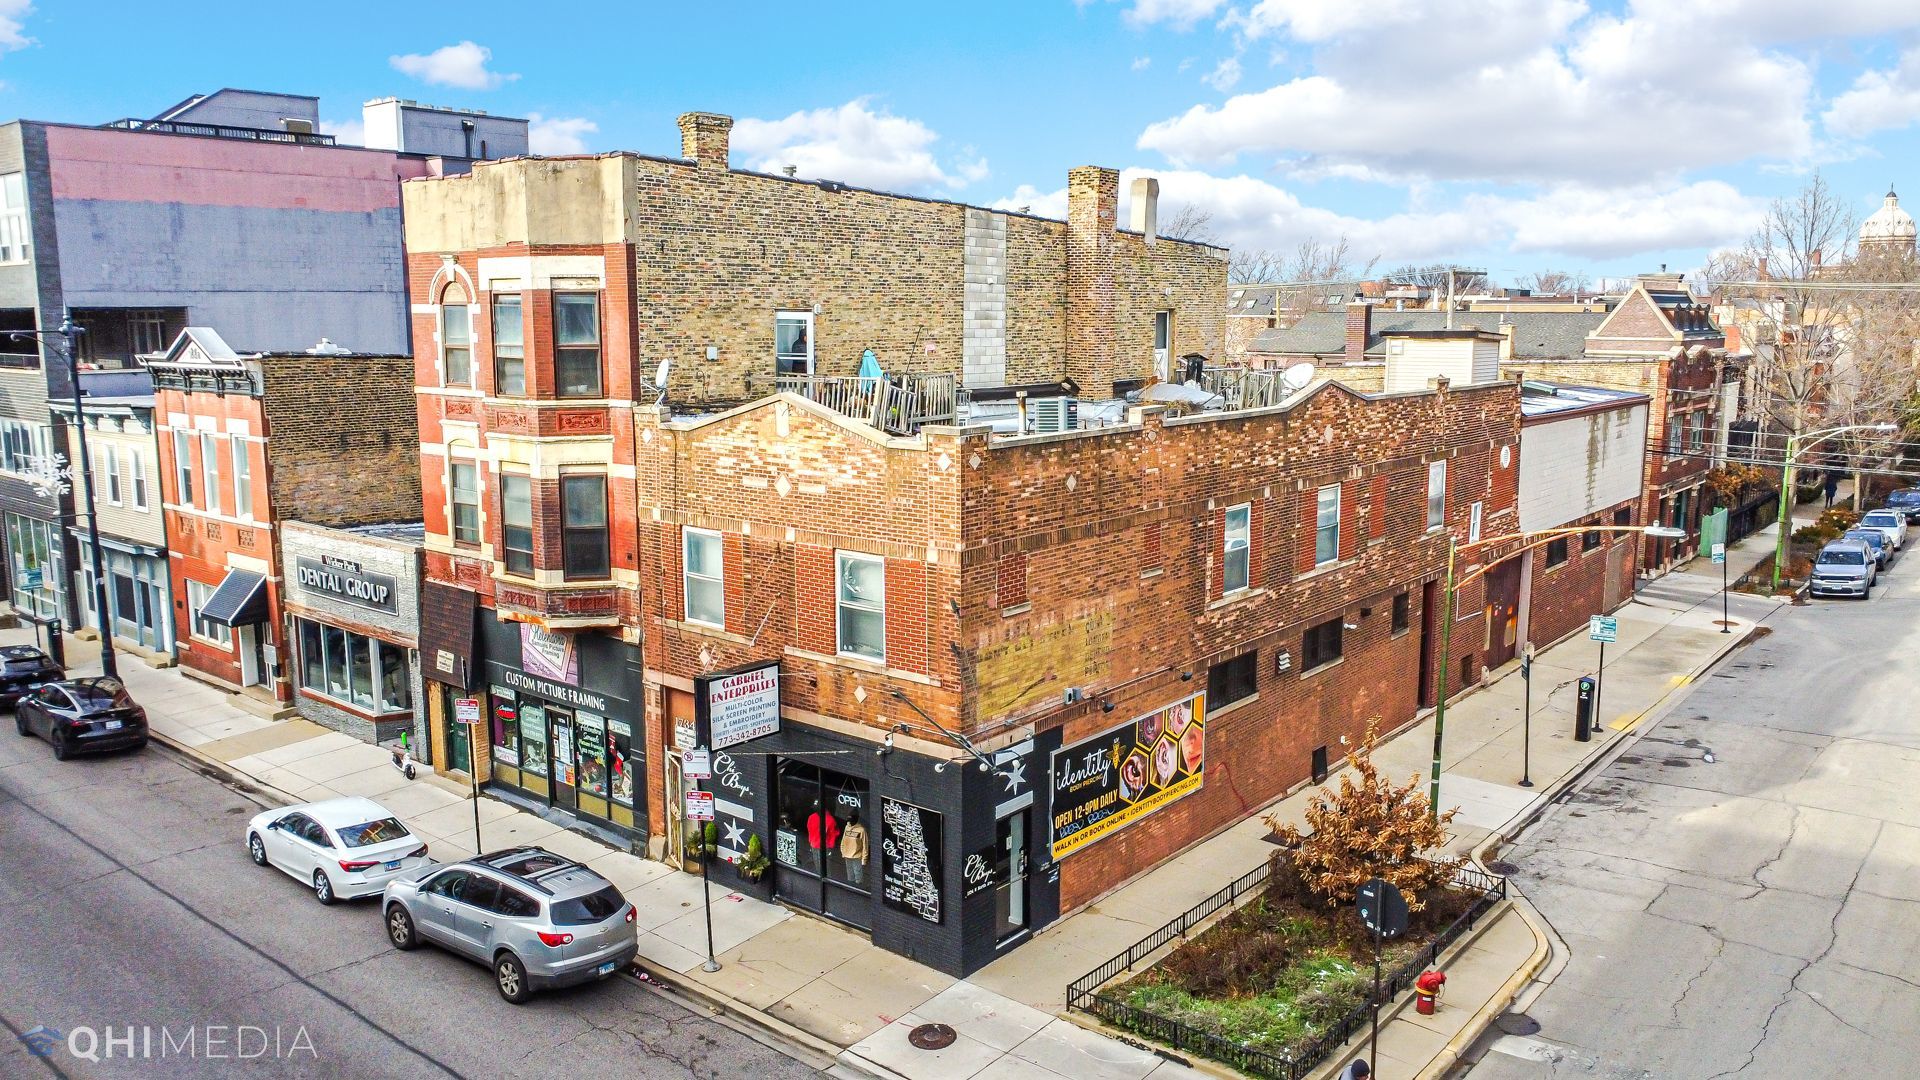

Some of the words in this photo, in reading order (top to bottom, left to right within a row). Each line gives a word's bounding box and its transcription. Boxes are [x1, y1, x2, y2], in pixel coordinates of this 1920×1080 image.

[325, 555, 344, 569] Wicker
[344, 560, 357, 572] Park
[299, 566, 342, 593] DENTAL
[345, 577, 389, 604] GROUP
[505, 671, 536, 691] CUSTOM
[537, 680, 567, 701] PICTURE
[568, 689, 605, 711] FRAMING
[711, 678, 776, 704] ENTERPRISES
[722, 670, 766, 690] GABRIEL
[712, 713, 725, 724] SILK
[726, 706, 748, 721] SCREEN
[748, 700, 777, 715] PRINTING
[724, 696, 764, 712] MULTI-COLOR
[729, 711, 766, 727] EMBROIDERY
[750, 716, 776, 728] SPORTSWEAR
[718, 724, 772, 748] 773-342-8705
[713, 750, 736, 775] Chi
[1056, 748, 1112, 791] identity
[721, 772, 750, 798] Boys
[1069, 782, 1082, 793] BODY
[1082, 773, 1104, 788] PIERCING
[837, 794, 862, 808] OPEN
[1055, 809, 1073, 830] OPEN
[1075, 797, 1099, 820] 12-9PM
[1100, 788, 1118, 808] DAILY
[1054, 840, 1072, 853] WALK
[1072, 836, 1079, 844] IN
[1080, 832, 1088, 841] OR
[1089, 824, 1106, 837] BOOK
[1106, 812, 1127, 828] ONLINE
[1130, 776, 1200, 816] IDENTITYBODYPIERCING.COM
